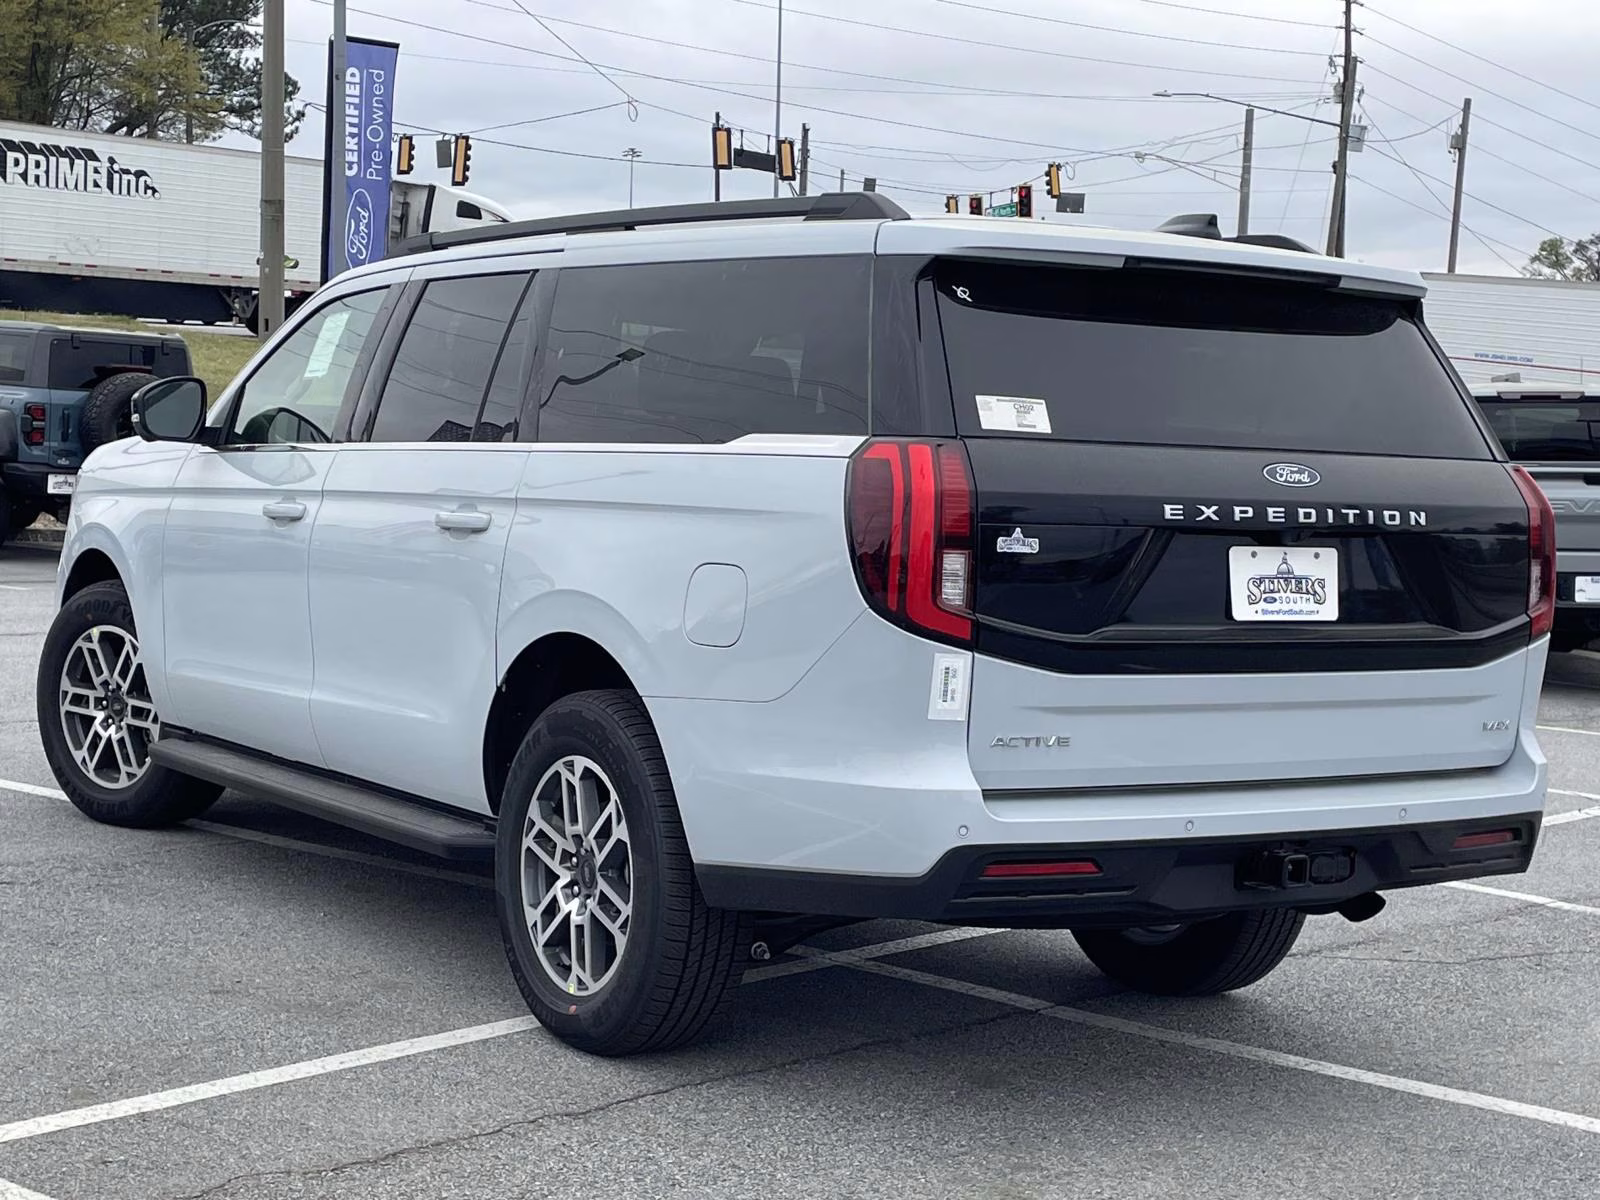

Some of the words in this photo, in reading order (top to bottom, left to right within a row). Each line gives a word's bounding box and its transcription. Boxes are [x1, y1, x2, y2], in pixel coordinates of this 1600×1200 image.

[345, 67, 361, 177] CERTIFIED
[366, 69, 385, 180] Pre-Owned
[5, 150, 102, 193] PRIME
[110, 158, 161, 200] inc.
[350, 206, 370, 260] Ford
[1275, 466, 1311, 484] Ford
[1163, 504, 1427, 526] EXPEDITION
[1550, 499, 1600, 513] EV
[1247, 577, 1327, 605] STIVERS
[1278, 596, 1311, 604] SOUTH
[990, 735, 1071, 747] ACTIVE
